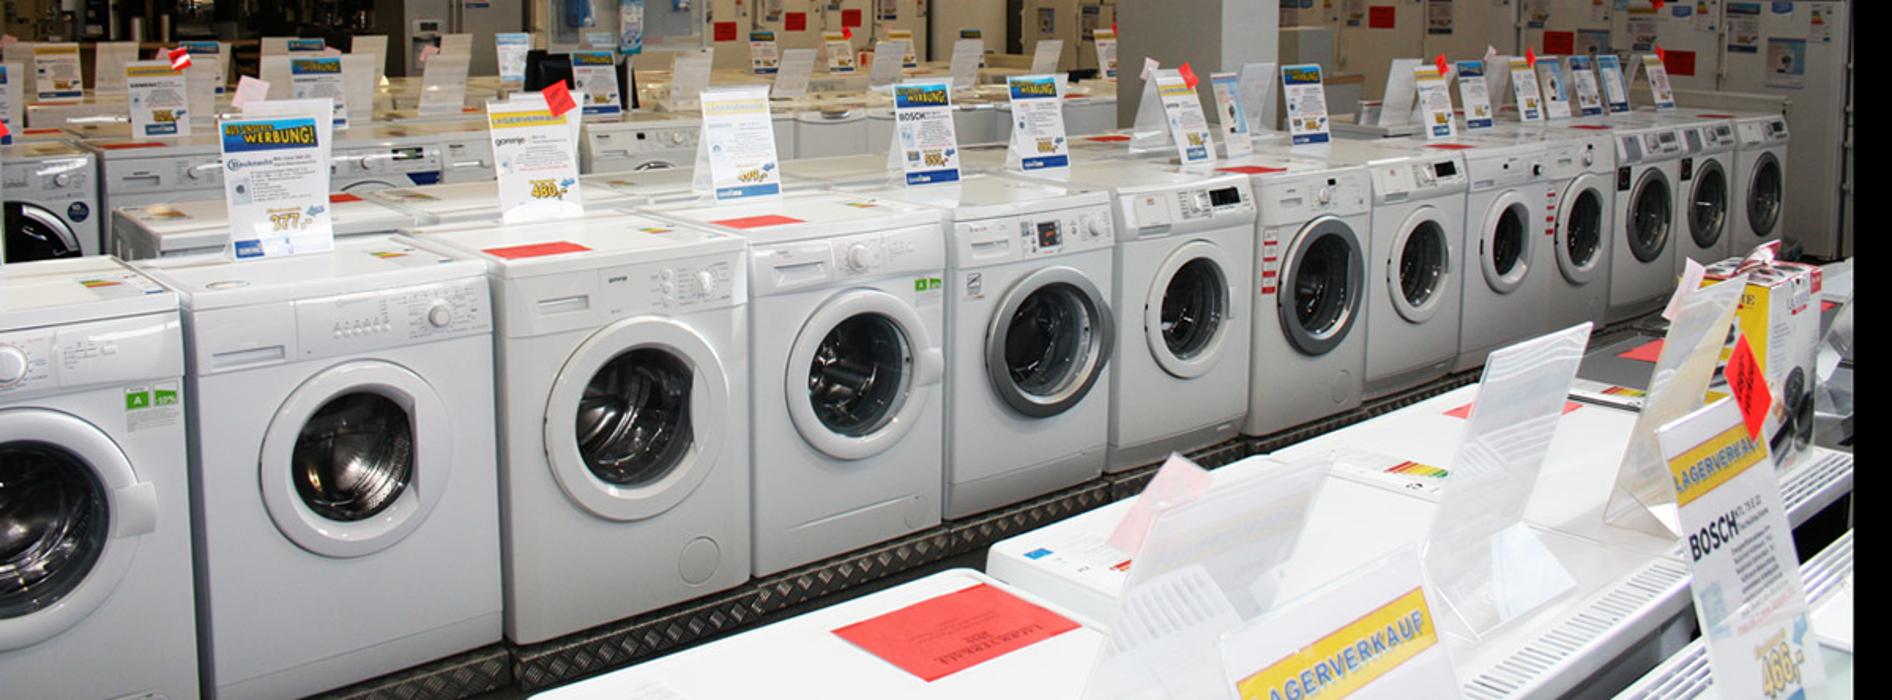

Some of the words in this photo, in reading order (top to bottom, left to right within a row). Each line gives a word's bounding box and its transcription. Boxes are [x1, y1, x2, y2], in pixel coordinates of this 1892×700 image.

[243, 126, 315, 145] WERBUNG!
[495, 136, 526, 147] gorenje
[133, 396, 142, 405] A
[1689, 510, 1739, 562] BOSCH
[1762, 641, 1805, 699] 466,-
